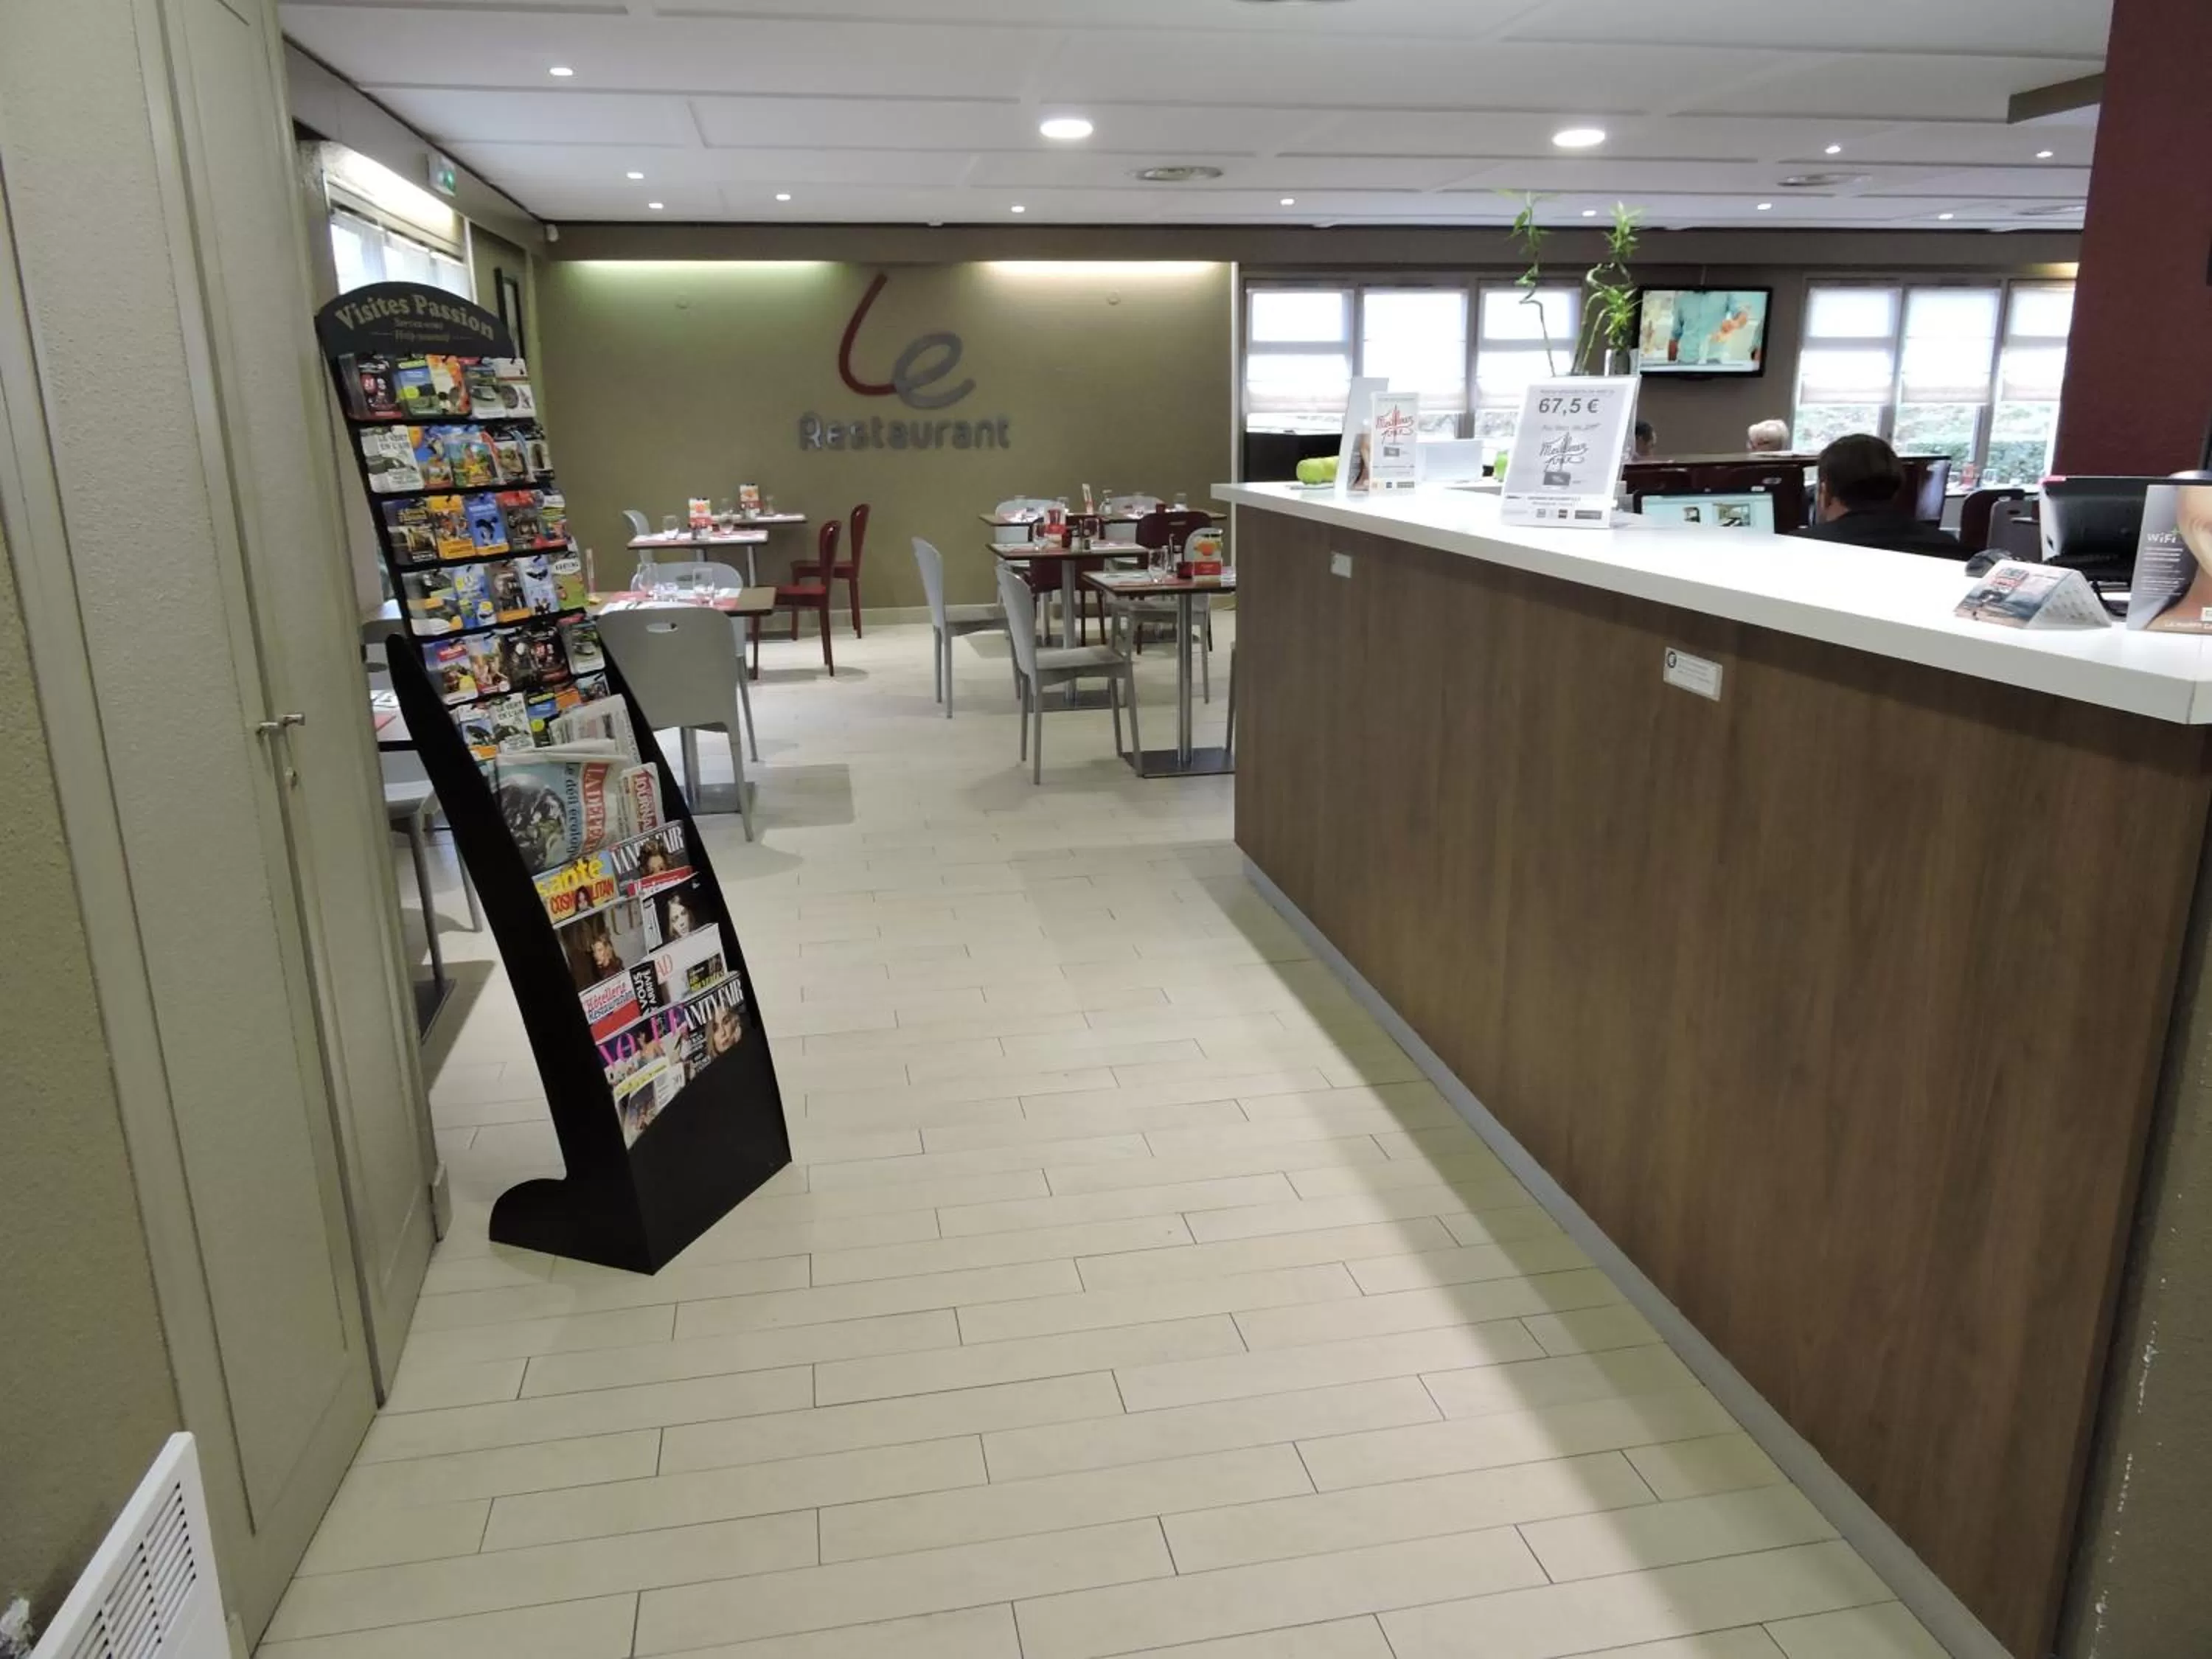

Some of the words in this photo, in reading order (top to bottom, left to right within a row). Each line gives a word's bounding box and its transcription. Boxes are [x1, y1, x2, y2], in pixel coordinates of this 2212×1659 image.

[335, 296, 410, 330] Visites
[413, 294, 494, 341] Passion
[838, 272, 976, 410] Le
[1539, 397, 1582, 417] 67,5
[1587, 399, 1599, 414] €
[799, 413, 1012, 451] Restaurant
[2147, 532, 2177, 543] WiFi
[633, 970, 650, 1012] VOUS
